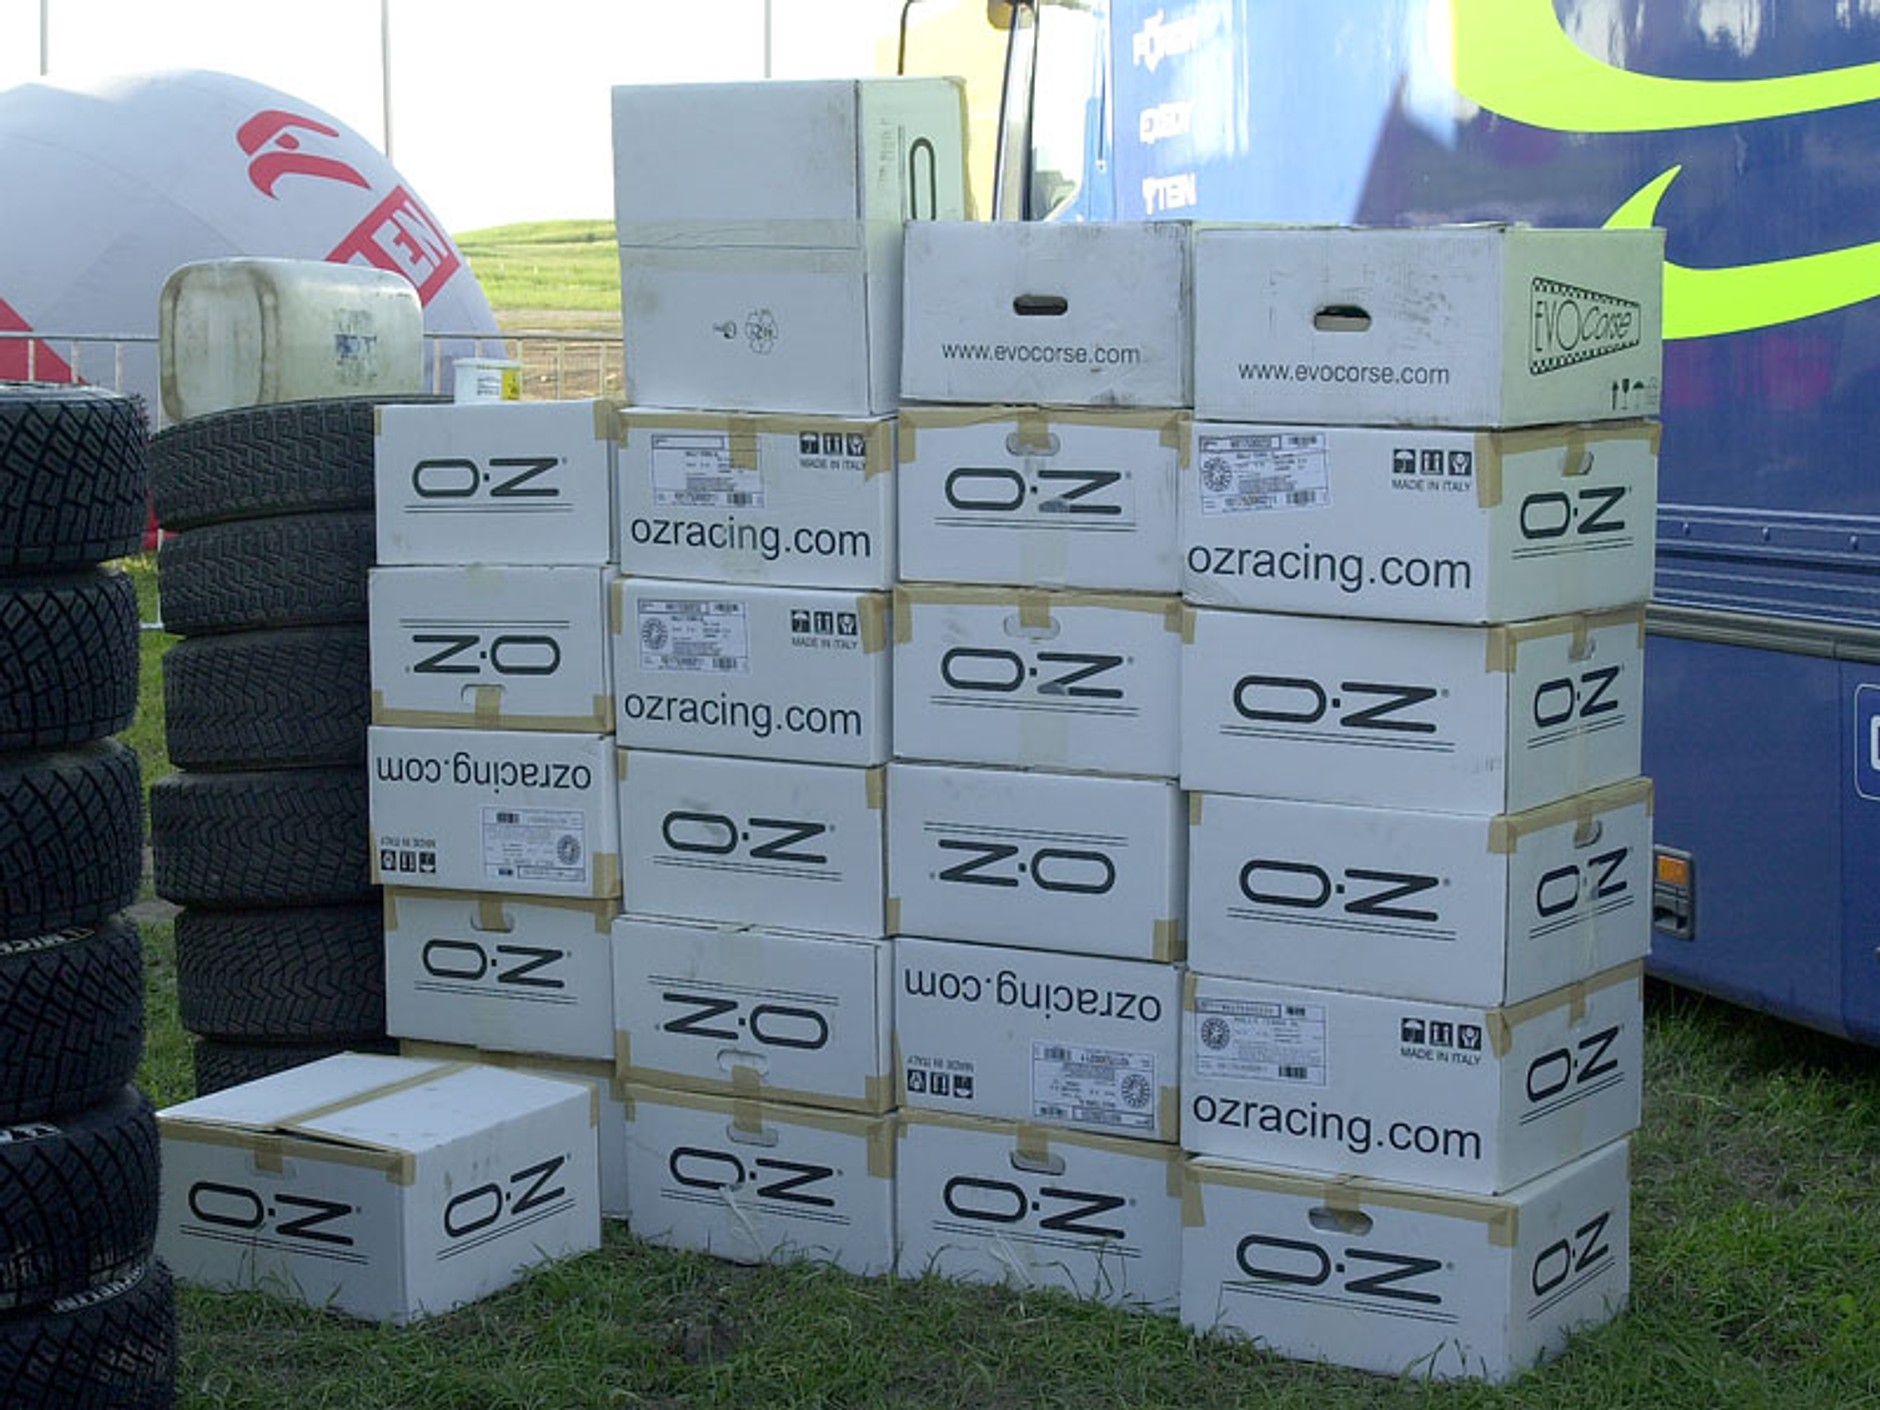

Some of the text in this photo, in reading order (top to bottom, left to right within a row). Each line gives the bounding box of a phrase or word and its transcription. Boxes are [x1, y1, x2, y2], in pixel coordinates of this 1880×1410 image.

[943, 345, 1140, 363] www.evocorse.com
[1239, 364, 1448, 384] www.evocorse.com
[1391, 479, 1471, 492] MADE IN ITALY
[632, 517, 870, 560] ozracing.com
[1188, 543, 1470, 592] ozracing.com
[792, 636, 818, 647] MADE
[821, 638, 831, 649] IN
[625, 693, 861, 737] ozracing.com
[378, 752, 590, 793] ozracing.com
[906, 970, 1161, 1021] ozracing.com
[1400, 1046, 1482, 1066] MADE IN ITALY
[1190, 1096, 1480, 1159] ozracing.com
